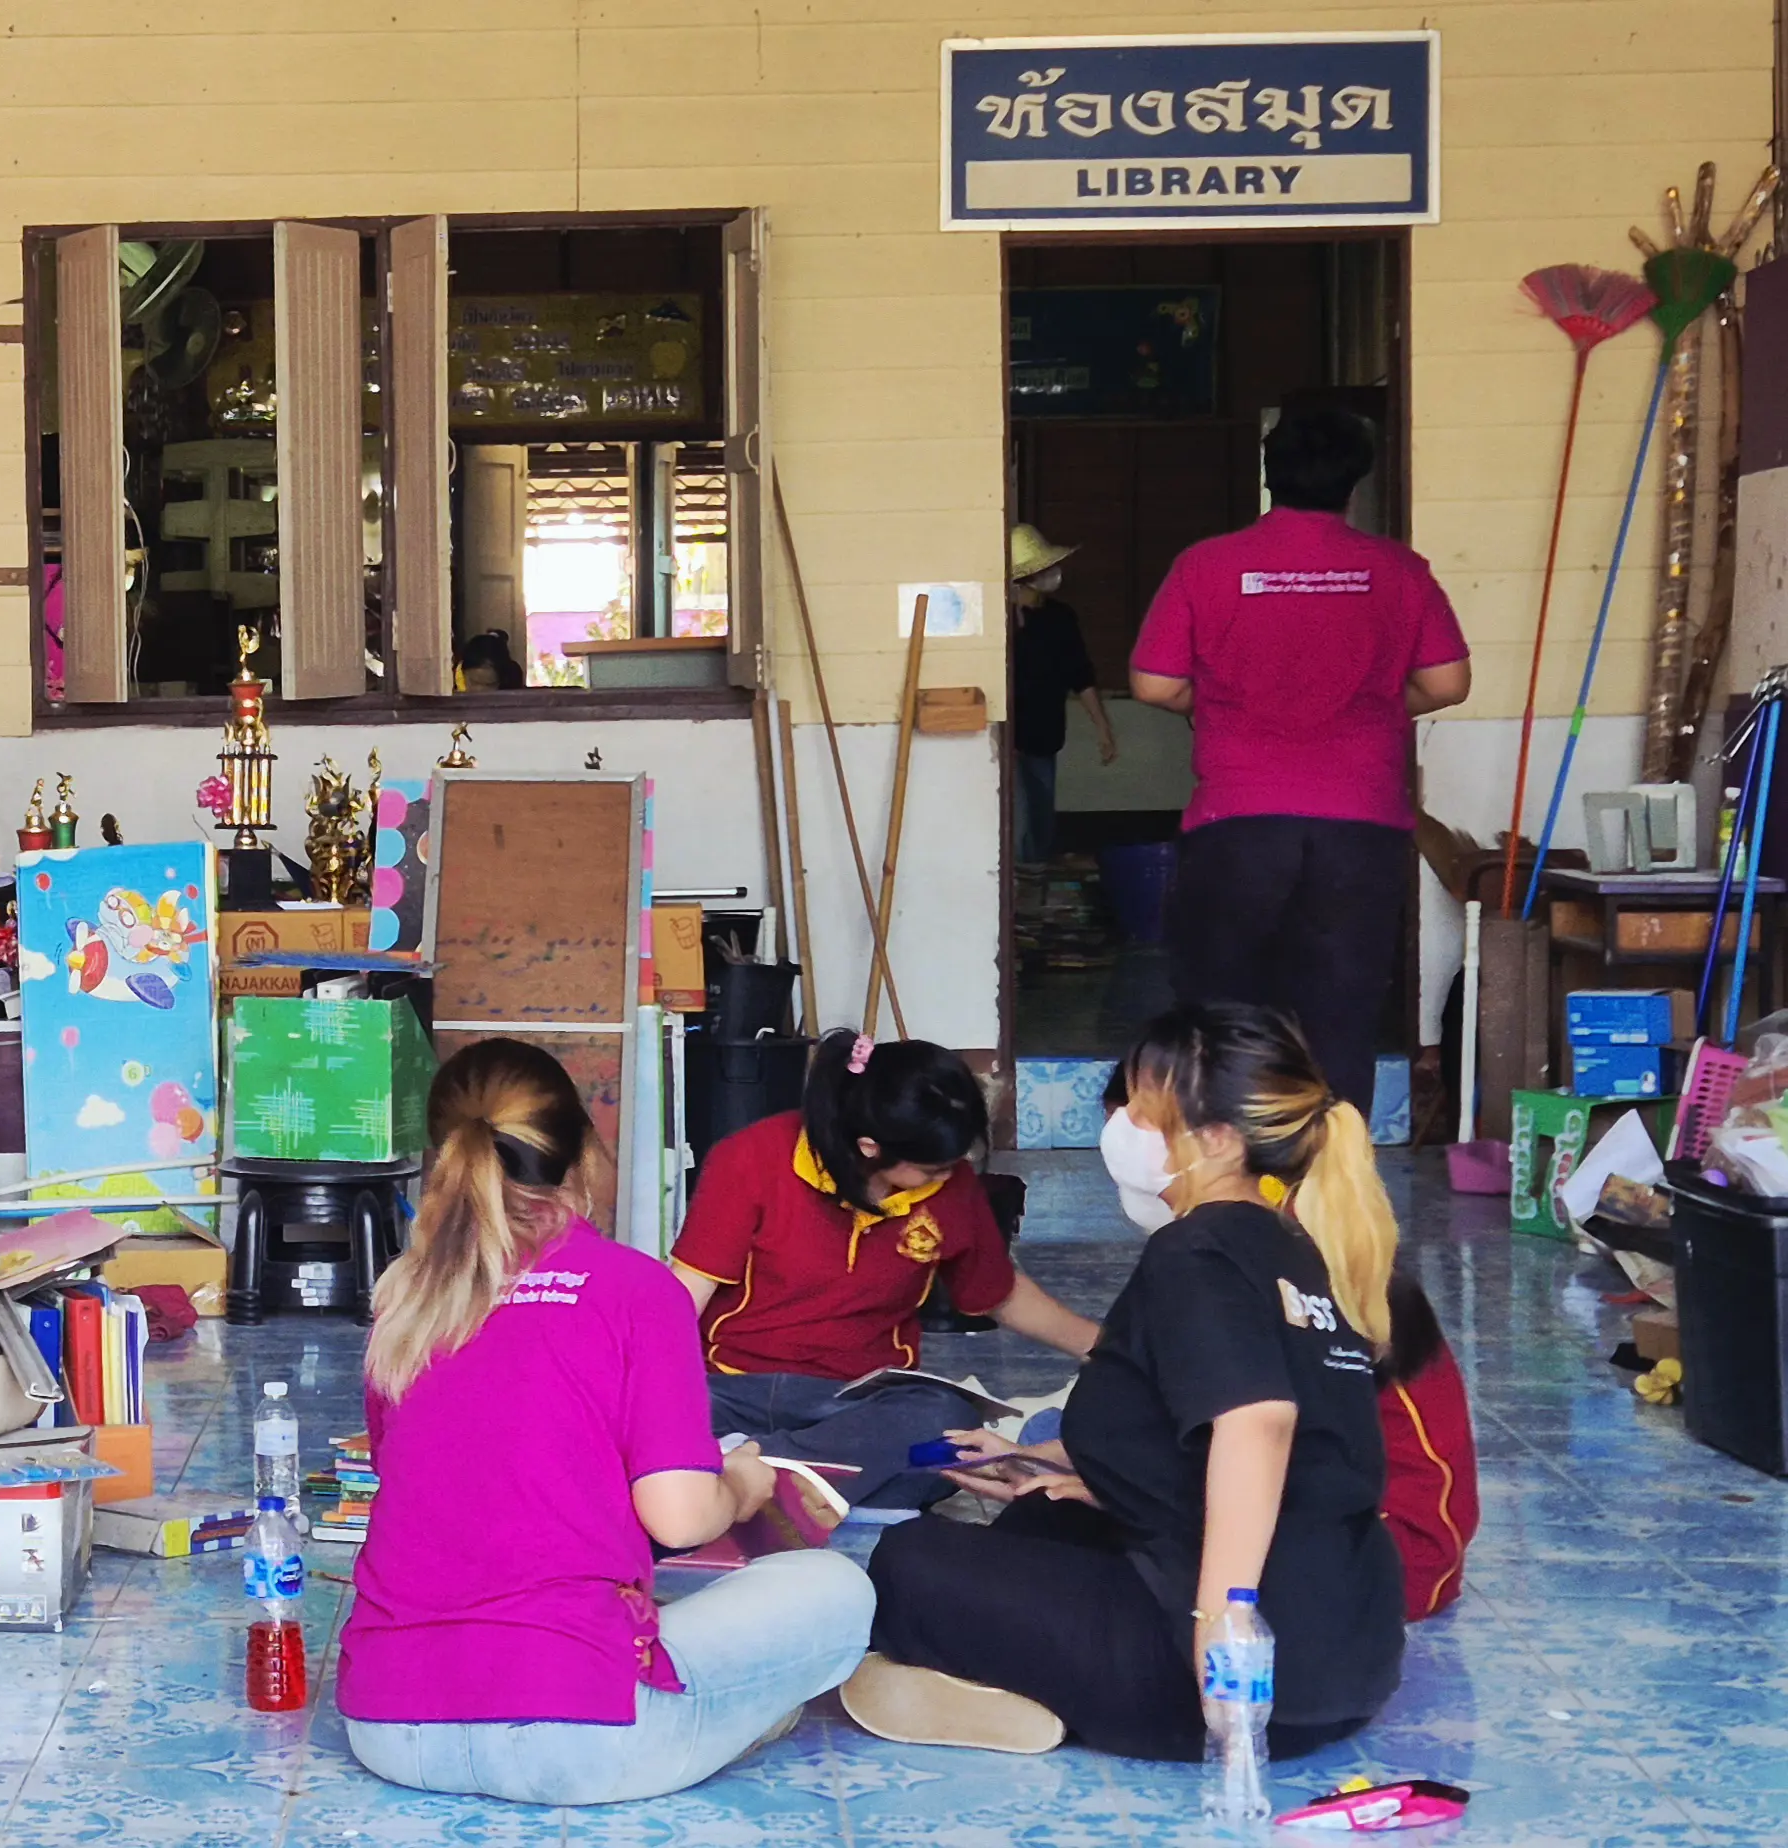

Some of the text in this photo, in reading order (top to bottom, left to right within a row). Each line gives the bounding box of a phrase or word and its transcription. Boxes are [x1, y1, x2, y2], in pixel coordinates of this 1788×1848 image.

[975, 67, 1394, 151] ห้องสมุด
[1076, 165, 1303, 197] LIBRARY
